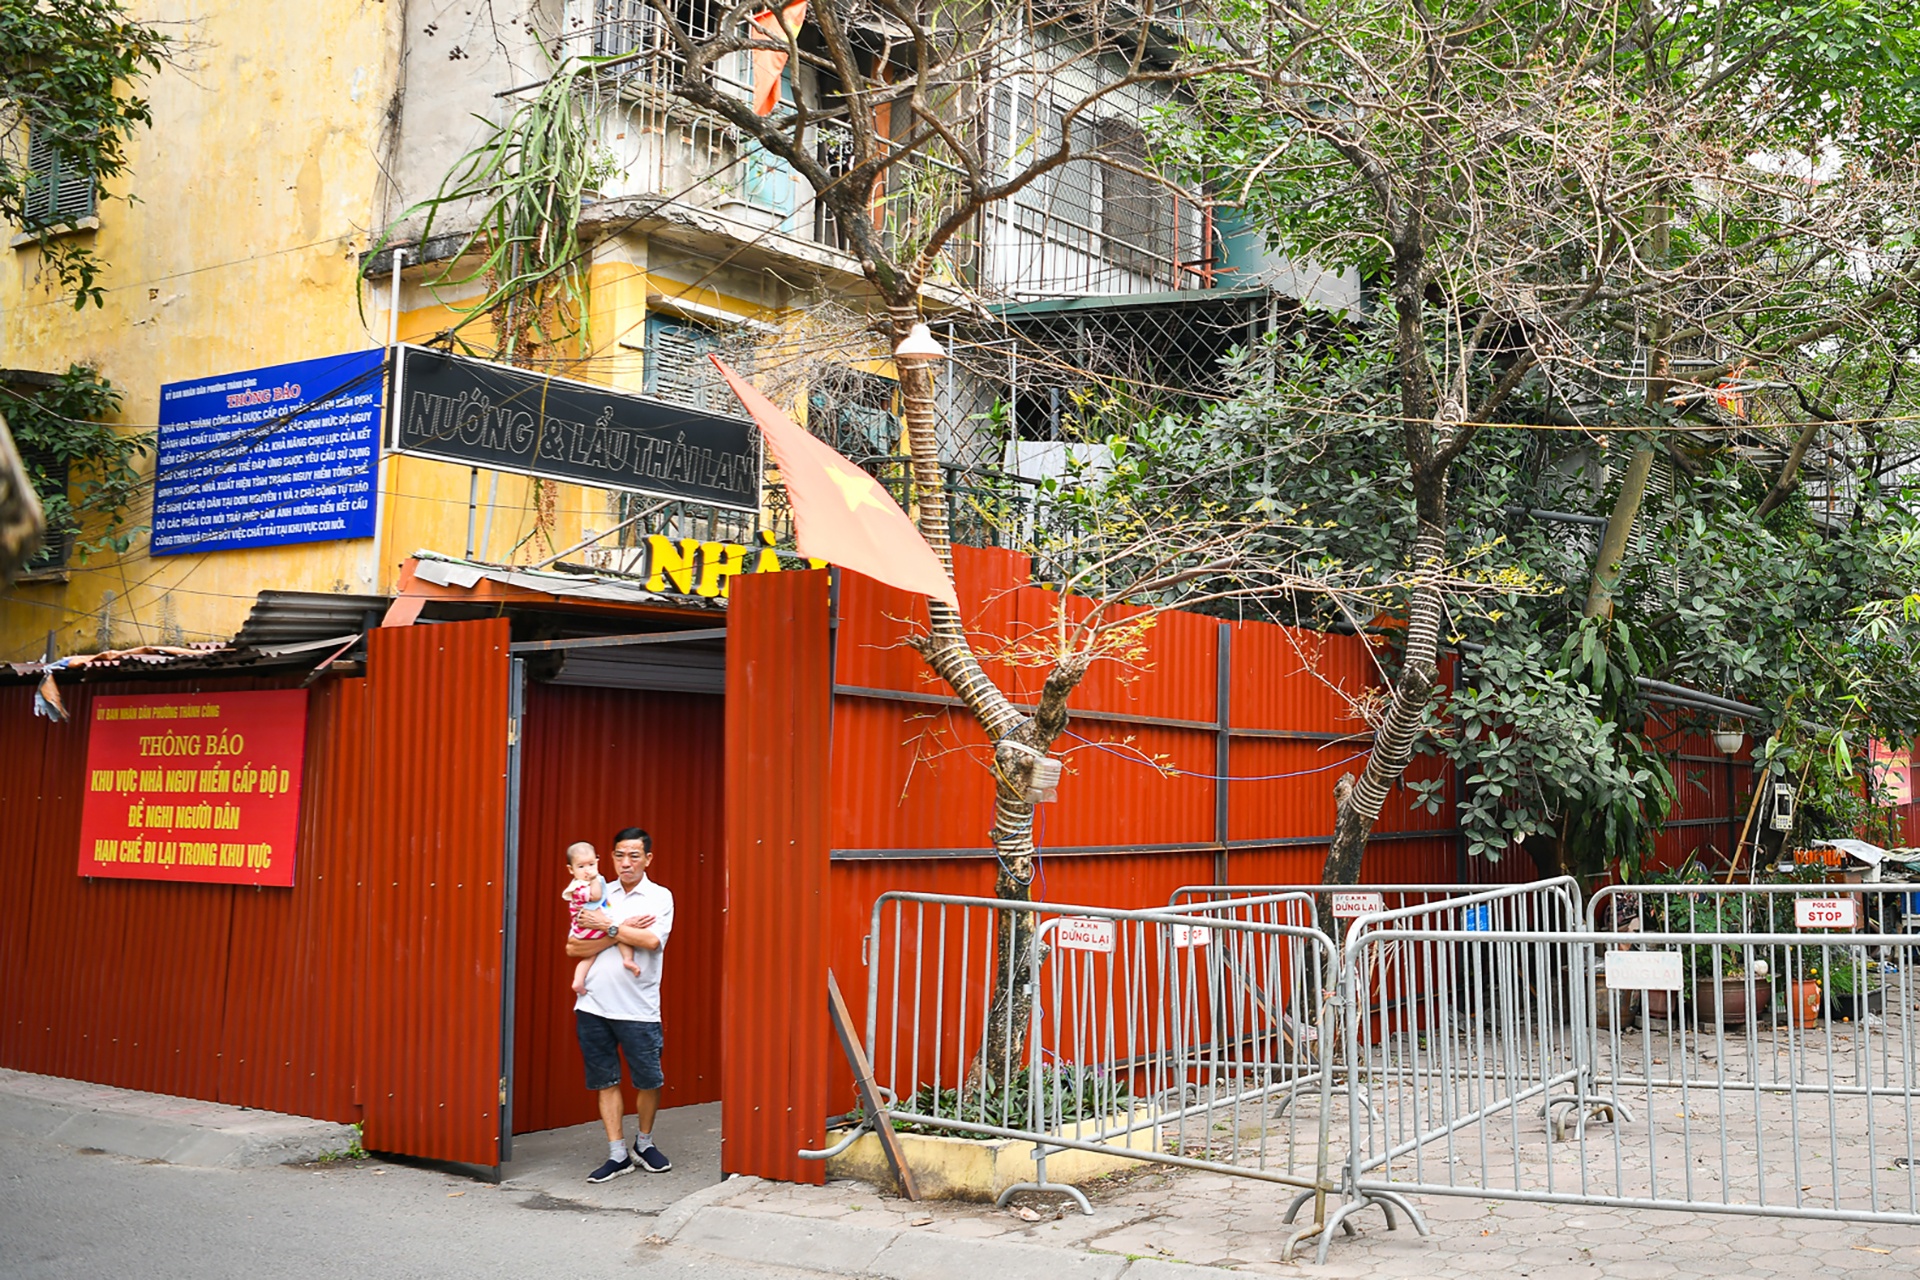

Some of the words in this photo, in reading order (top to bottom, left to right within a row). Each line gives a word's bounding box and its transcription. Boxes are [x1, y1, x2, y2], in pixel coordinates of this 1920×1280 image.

[226, 388, 271, 408] THÔNG
[273, 382, 301, 401] BÁO
[262, 405, 277, 419] CẤP
[278, 404, 289, 417] CÓ
[191, 432, 208, 445] CHẤT
[350, 411, 372, 423] NGUY
[271, 437, 286, 451] KHẢ
[286, 436, 307, 449] NĂNG
[340, 428, 356, 442] CỦA
[357, 426, 372, 440] KẾT
[407, 387, 534, 454] NƯỚNG
[539, 419, 564, 460] &
[568, 405, 630, 471] LẨU
[633, 430, 699, 484] THÁI
[700, 447, 756, 494] LAN
[305, 451, 319, 463] YÊU
[320, 448, 336, 462] CẤU
[216, 477, 235, 491] XUẤT
[235, 477, 251, 490] HIỆN
[292, 471, 313, 482] NGUY
[332, 462, 353, 477] TỔNG
[167, 518, 180, 529] CÁC
[336, 498, 351, 512] KẾT
[351, 496, 368, 510] CẤU
[182, 499, 196, 511] CÁC
[196, 497, 206, 511] HỘ
[206, 496, 221, 508] DÂN
[283, 488, 294, 500] VÀ
[155, 535, 173, 546] CÔNG
[247, 524, 265, 538] CHẤT
[288, 523, 304, 533] KHU
[645, 529, 781, 598] NHÀ
[96, 704, 106, 720] ỦY
[106, 709, 119, 720] BAN
[120, 705, 137, 720] NHÂN
[138, 705, 152, 719] DÂN
[153, 704, 178, 719] PHƯỜNG
[179, 704, 199, 718] THÀNH
[201, 704, 219, 718] CÔNG
[139, 729, 201, 756] THÔNG
[205, 728, 244, 756] BÁO
[91, 770, 113, 792] KHU
[116, 768, 137, 796] VỰC
[140, 766, 163, 792] NHÀ
[166, 770, 197, 793] NGUY
[199, 760, 230, 793] HIỂM
[232, 762, 257, 793] CẤP
[259, 765, 278, 799] ĐỘ
[280, 770, 289, 793] D
[128, 797, 145, 827] ĐỀ
[145, 806, 174, 833] NGHỊ
[175, 801, 212, 828] NGƯỜI
[214, 802, 240, 829] DÂN
[94, 840, 118, 866] HẠN
[119, 833, 144, 862] CHẾ
[143, 841, 156, 864] ĐI
[158, 842, 176, 869] LẠI
[179, 842, 217, 866] TRONG
[219, 844, 245, 867] KHU
[247, 842, 272, 873] VỰC
[1809, 912, 1842, 921] STOP
[1092, 935, 1109, 946] LẠI
[1183, 930, 1202, 940] SOP
